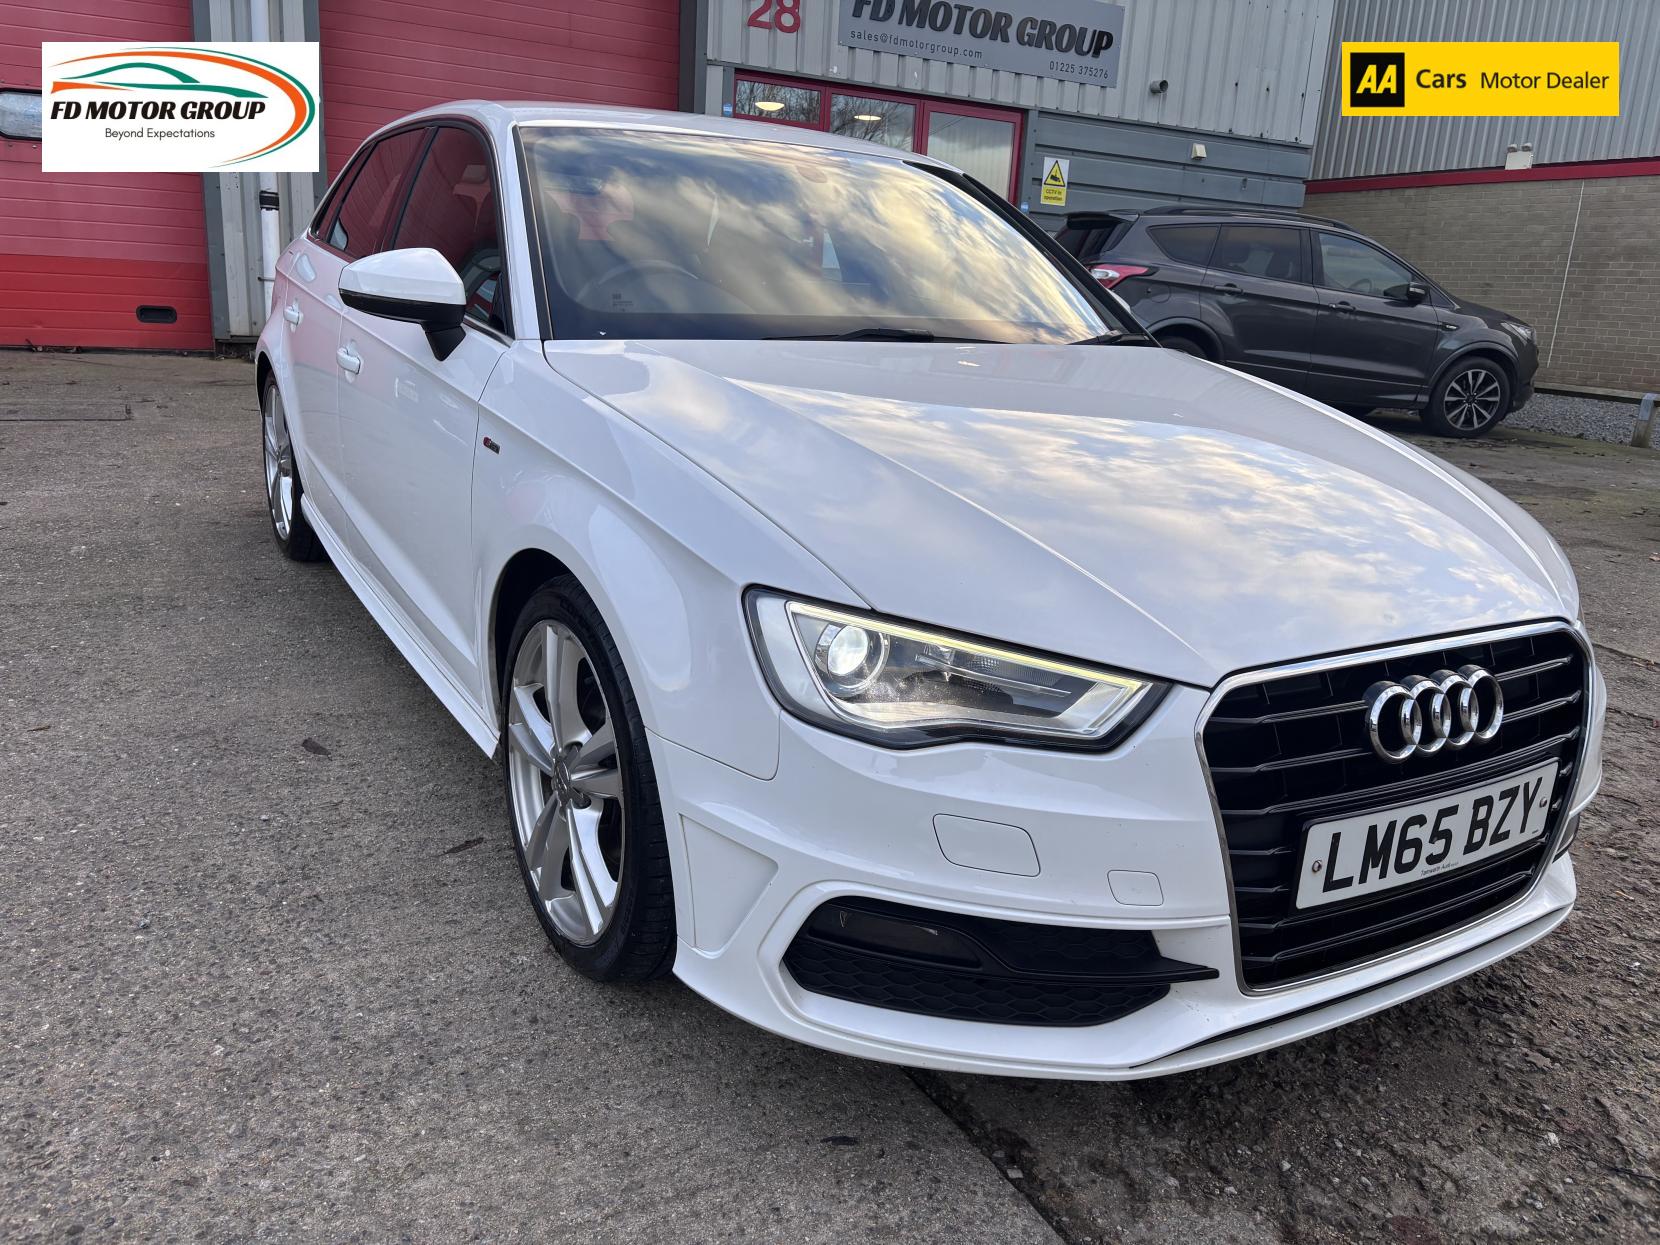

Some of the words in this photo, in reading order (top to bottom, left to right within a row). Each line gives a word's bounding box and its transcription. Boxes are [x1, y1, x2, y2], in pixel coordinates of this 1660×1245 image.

[747, 0, 800, 33] 28
[852, 0, 895, 22] FD
[898, 0, 1013, 43] MOTOR
[1016, 16, 1114, 59] GROUP
[850, 30, 983, 59] sales@fdmotorgroup.com
[1049, 60, 1076, 74] 01225
[1078, 65, 1109, 79] 375276
[1322, 804, 1459, 893] LM65
[1463, 777, 1543, 856] BZY
